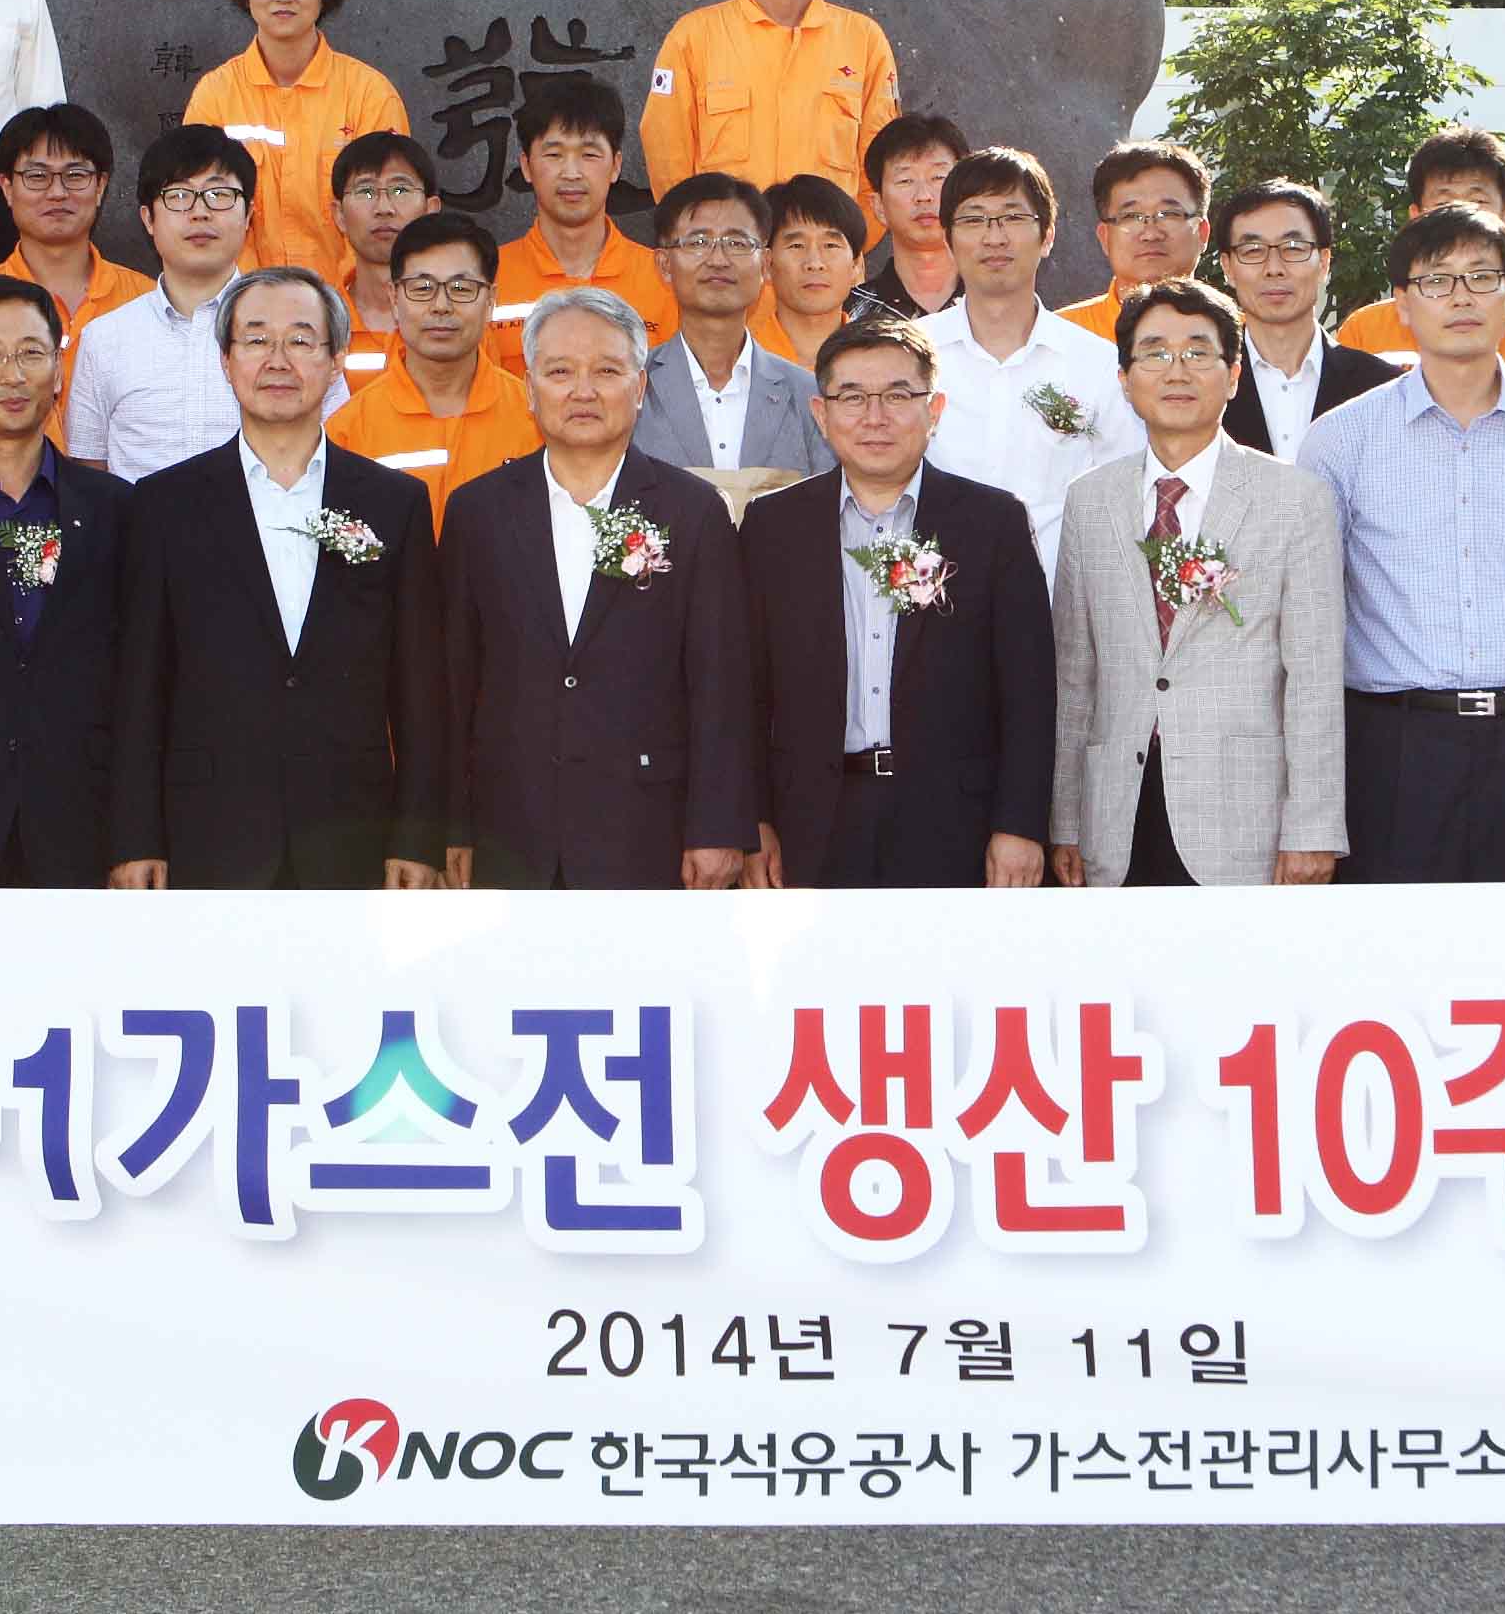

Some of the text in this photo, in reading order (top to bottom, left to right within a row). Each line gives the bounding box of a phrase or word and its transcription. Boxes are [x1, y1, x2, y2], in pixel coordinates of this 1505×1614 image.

[765, 1002, 1144, 1241] 생산
[546, 1308, 1250, 1386] 2014년 7월 11일
[292, 1398, 574, 1501] KNOC
[590, 1430, 982, 1500] 한국석유공사
